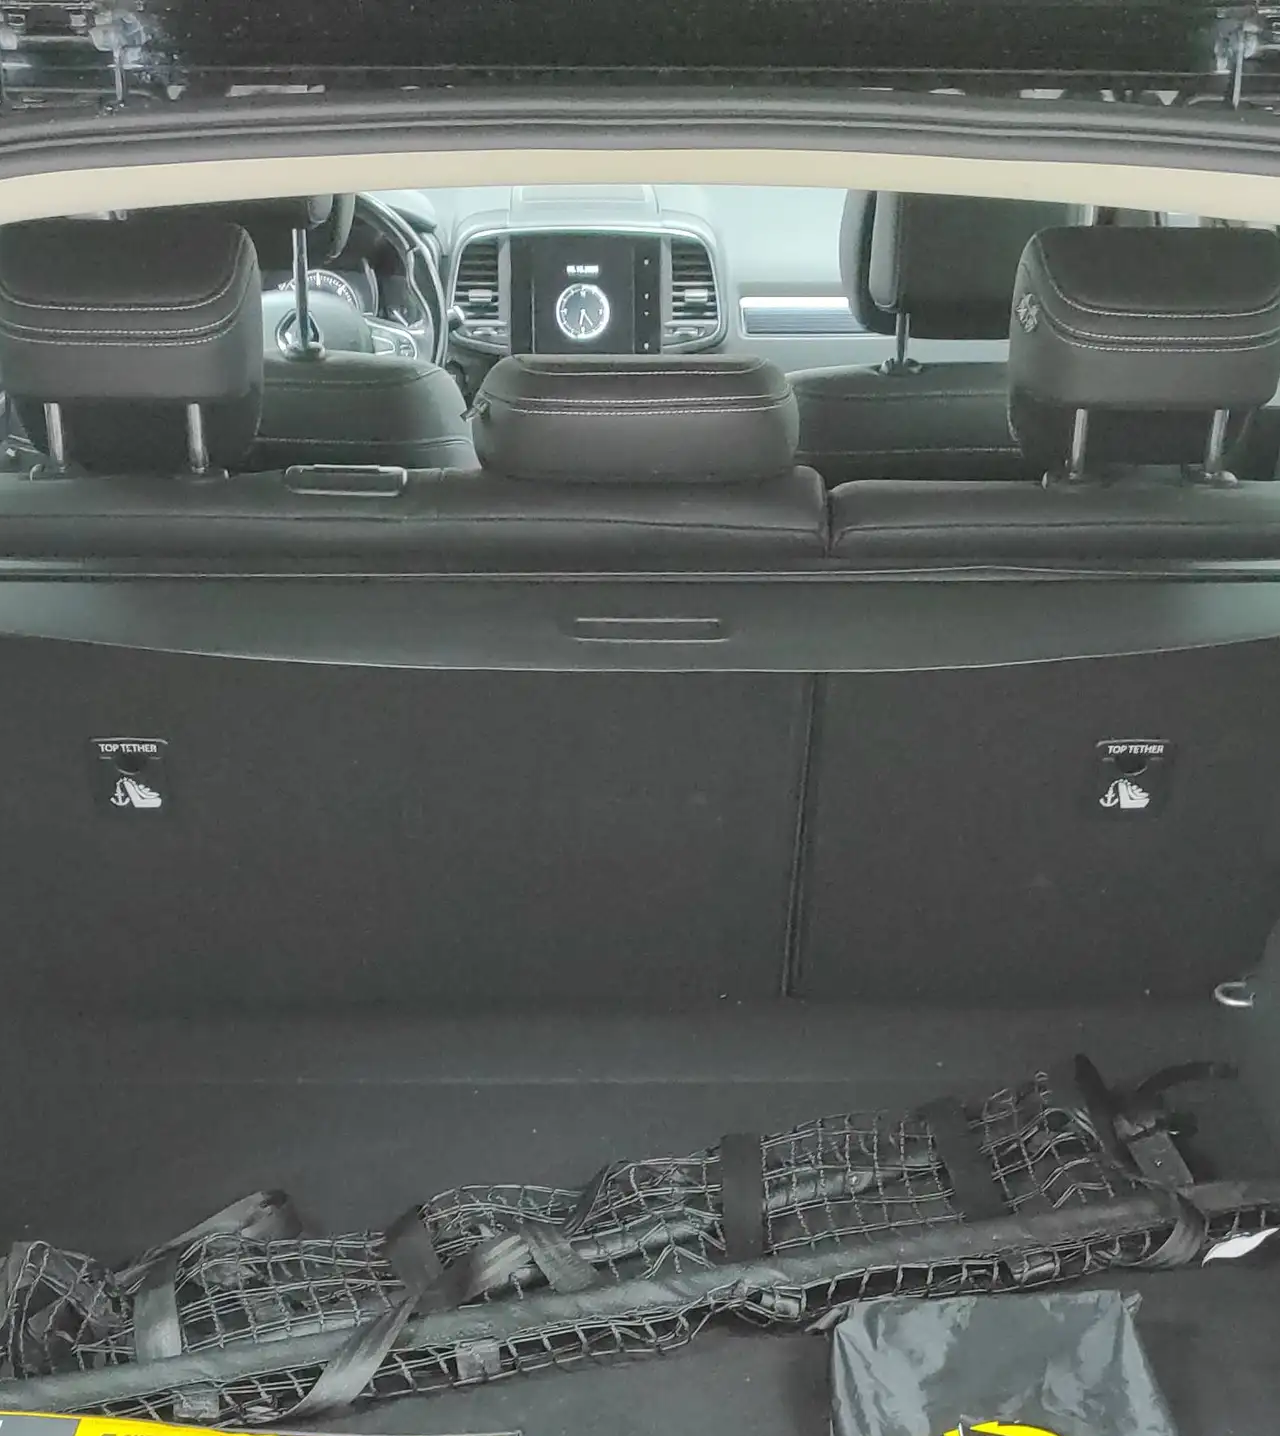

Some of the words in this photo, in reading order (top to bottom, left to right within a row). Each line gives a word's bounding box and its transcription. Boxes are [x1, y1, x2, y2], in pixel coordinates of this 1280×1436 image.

[99, 743, 119, 753] TOP
[120, 743, 157, 753] TETHER
[1108, 744, 1127, 754] TOP
[1128, 744, 1164, 754] TETHER
